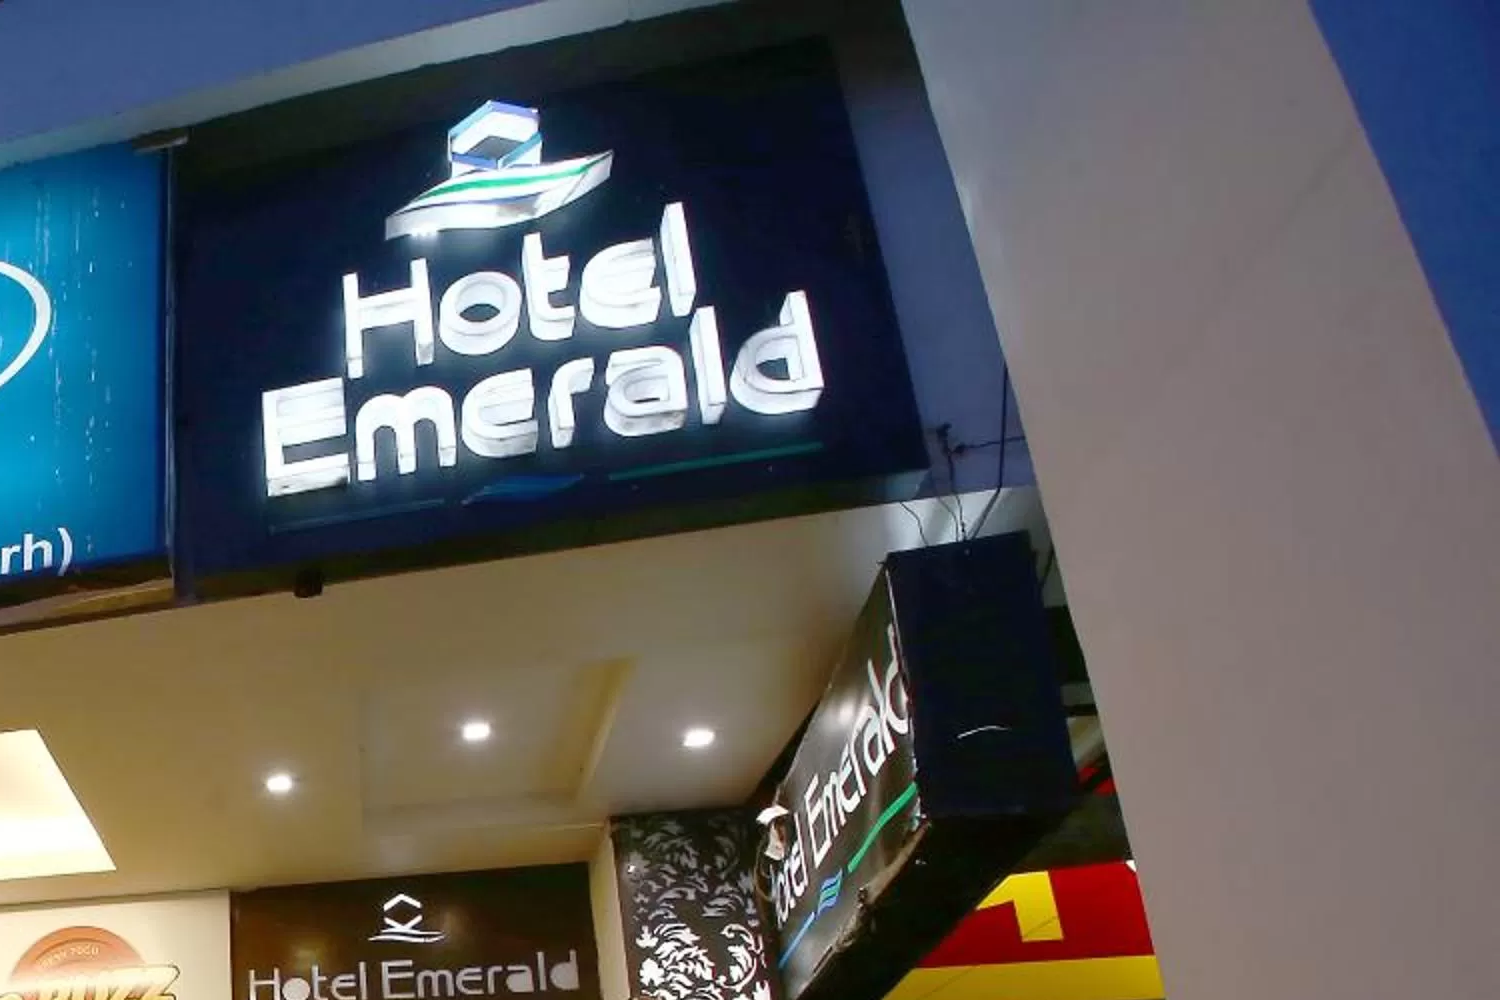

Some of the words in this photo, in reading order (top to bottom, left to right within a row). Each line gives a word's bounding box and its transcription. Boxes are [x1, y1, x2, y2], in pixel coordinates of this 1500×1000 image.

[342, 201, 697, 379] Hotel
[261, 289, 825, 498] Emerald
[804, 622, 910, 869] Emerald
[381, 949, 581, 1000] Emerald
